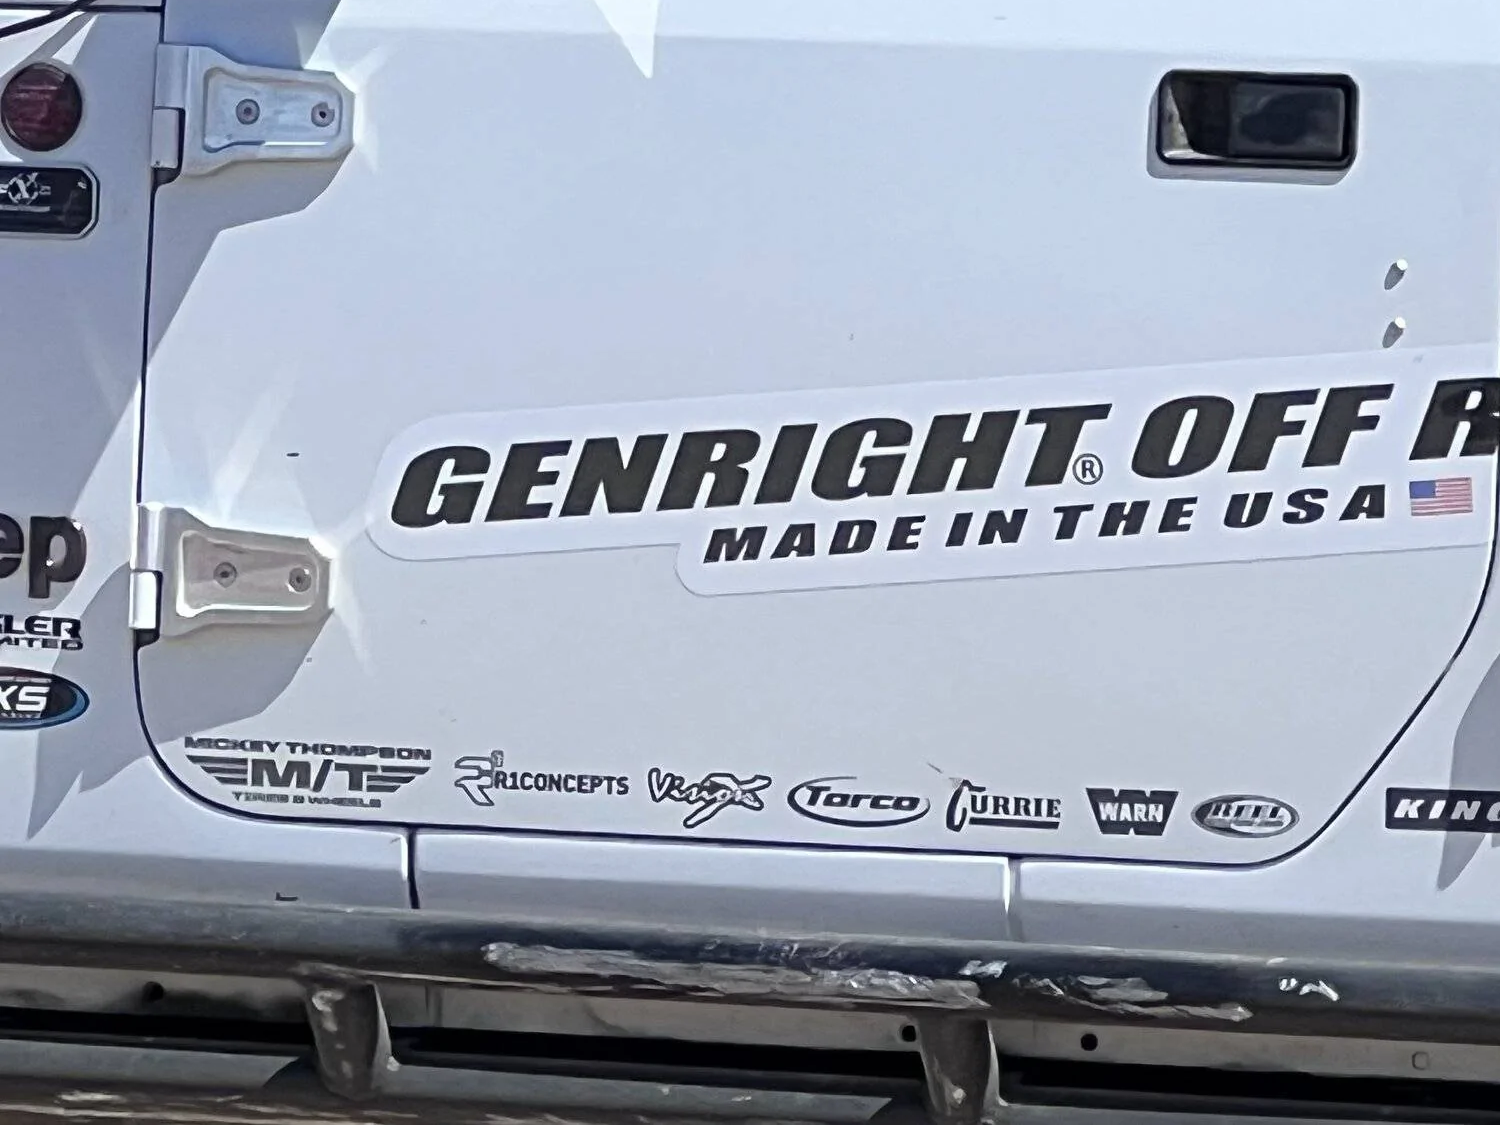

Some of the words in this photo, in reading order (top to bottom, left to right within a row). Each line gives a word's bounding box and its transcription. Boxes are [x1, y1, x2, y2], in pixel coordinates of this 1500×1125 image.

[1131, 383, 1394, 479] OFF
[703, 515, 926, 564] MADE
[945, 508, 1028, 548] IN
[1054, 497, 1199, 539] THE
[1223, 484, 1387, 531] USA
[0, 614, 82, 641] LER
[251, 759, 378, 793] M/T
[493, 771, 630, 796] R1CONCEPTS
[946, 779, 1061, 832] CURRIE
[1098, 801, 1165, 823] WARN
